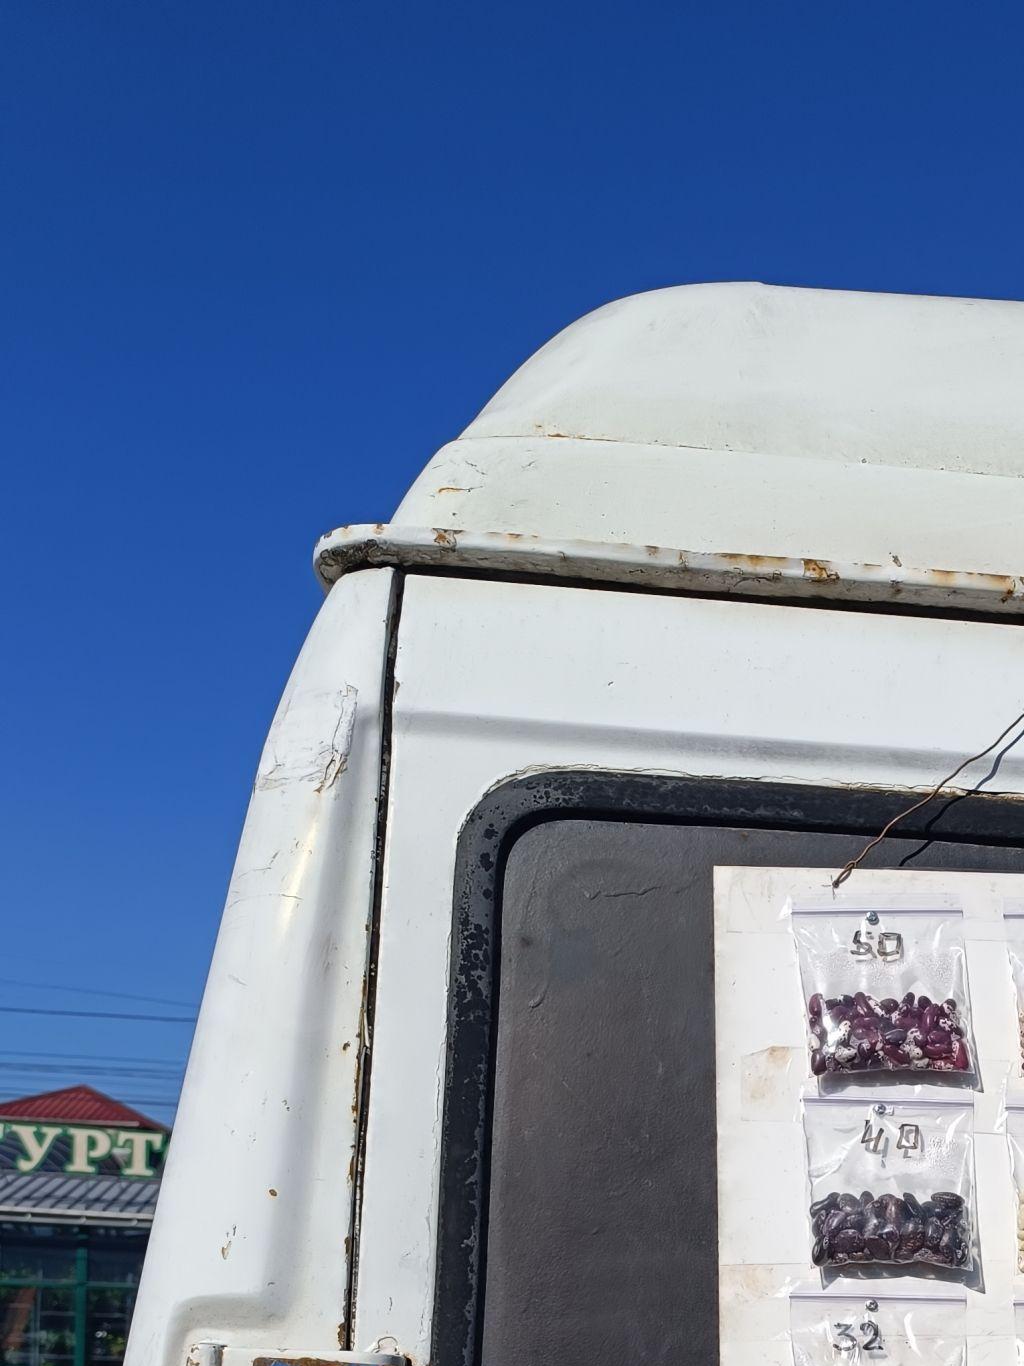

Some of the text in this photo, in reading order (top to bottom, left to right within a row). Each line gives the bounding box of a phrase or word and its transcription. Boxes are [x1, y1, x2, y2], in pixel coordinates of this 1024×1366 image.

[850, 930, 902, 956] 50
[0, 1123, 163, 1176] УРТ
[861, 1119, 920, 1154] 40
[833, 1320, 884, 1352] 32
